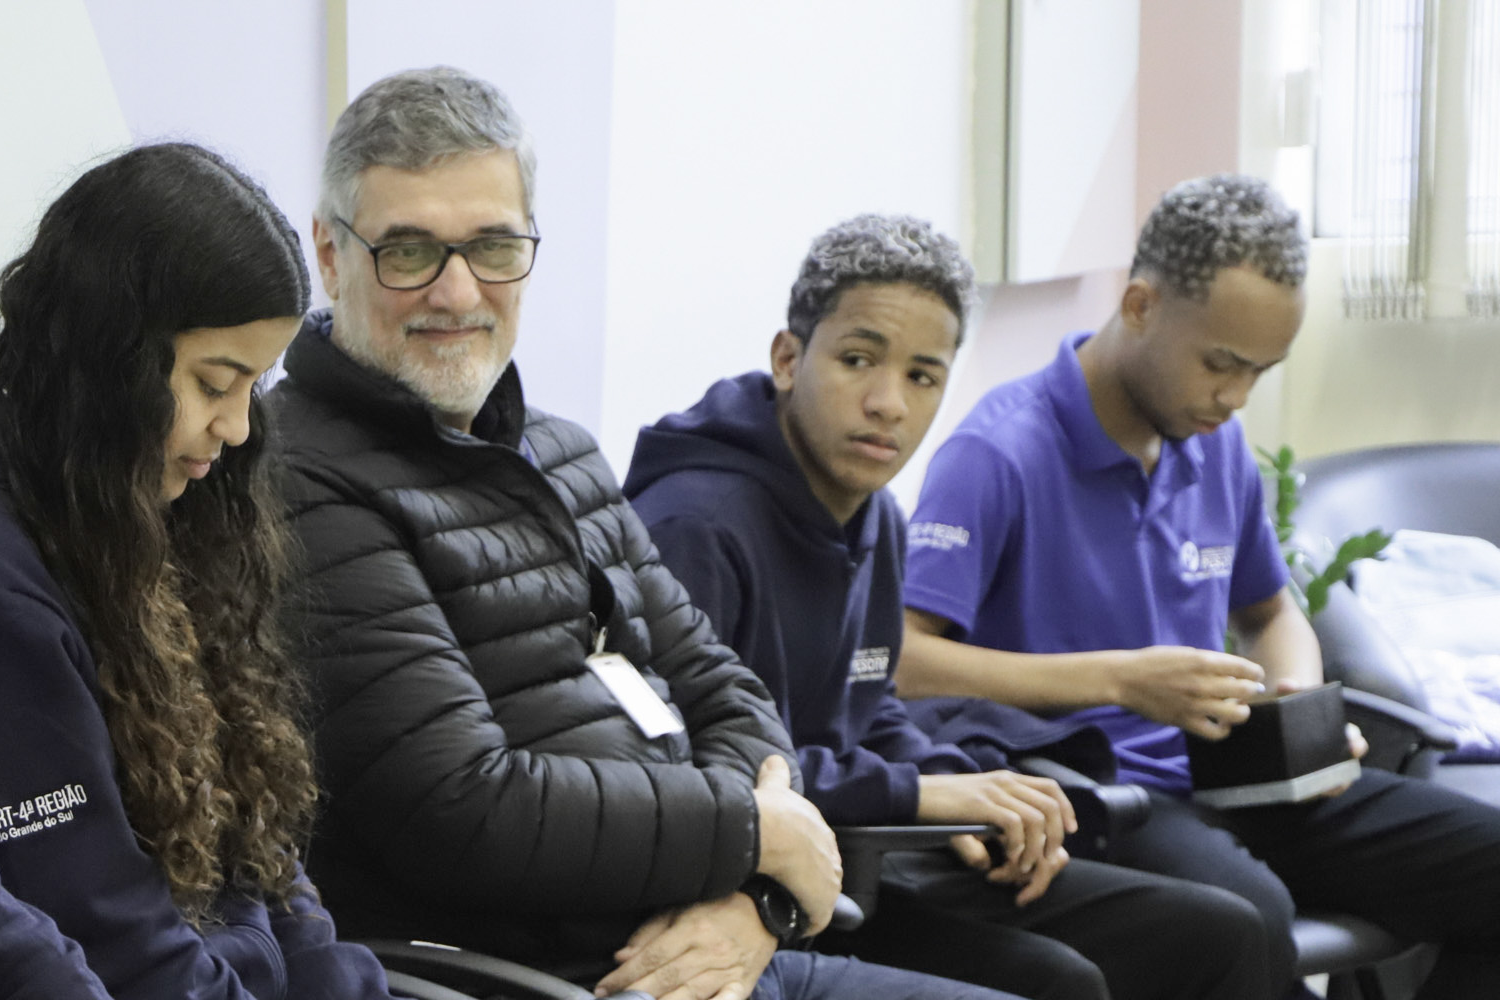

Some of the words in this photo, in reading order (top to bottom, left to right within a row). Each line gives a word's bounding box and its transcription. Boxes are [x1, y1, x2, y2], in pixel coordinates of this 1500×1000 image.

[34, 784, 88, 816] REGIÃO
[9, 821, 44, 839] Grande
[44, 816, 57, 828] do
[58, 810, 74, 823] Sul
